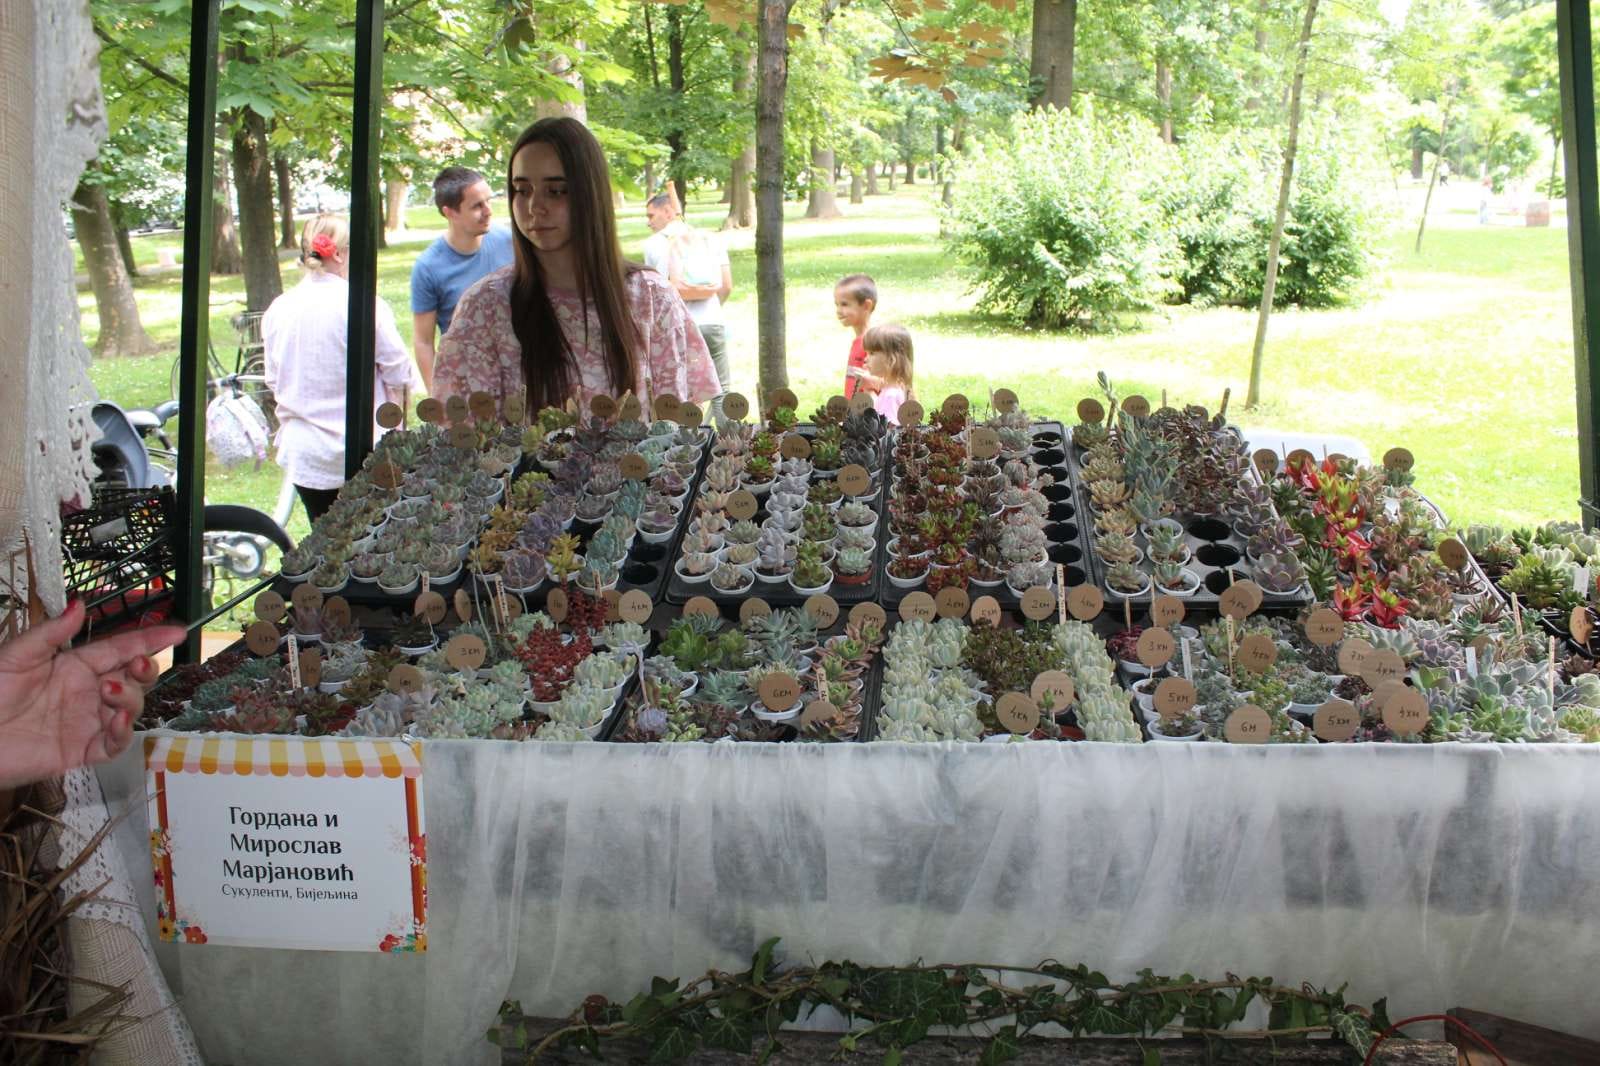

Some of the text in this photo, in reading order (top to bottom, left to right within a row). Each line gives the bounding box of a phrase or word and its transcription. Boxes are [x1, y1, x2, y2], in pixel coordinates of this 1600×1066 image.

[229, 806, 338, 830] Гордана и
[230, 833, 342, 857] Мирослав
[223, 859, 354, 883] Марјановић
[222, 884, 358, 901] Сукуленти, Бијељина
